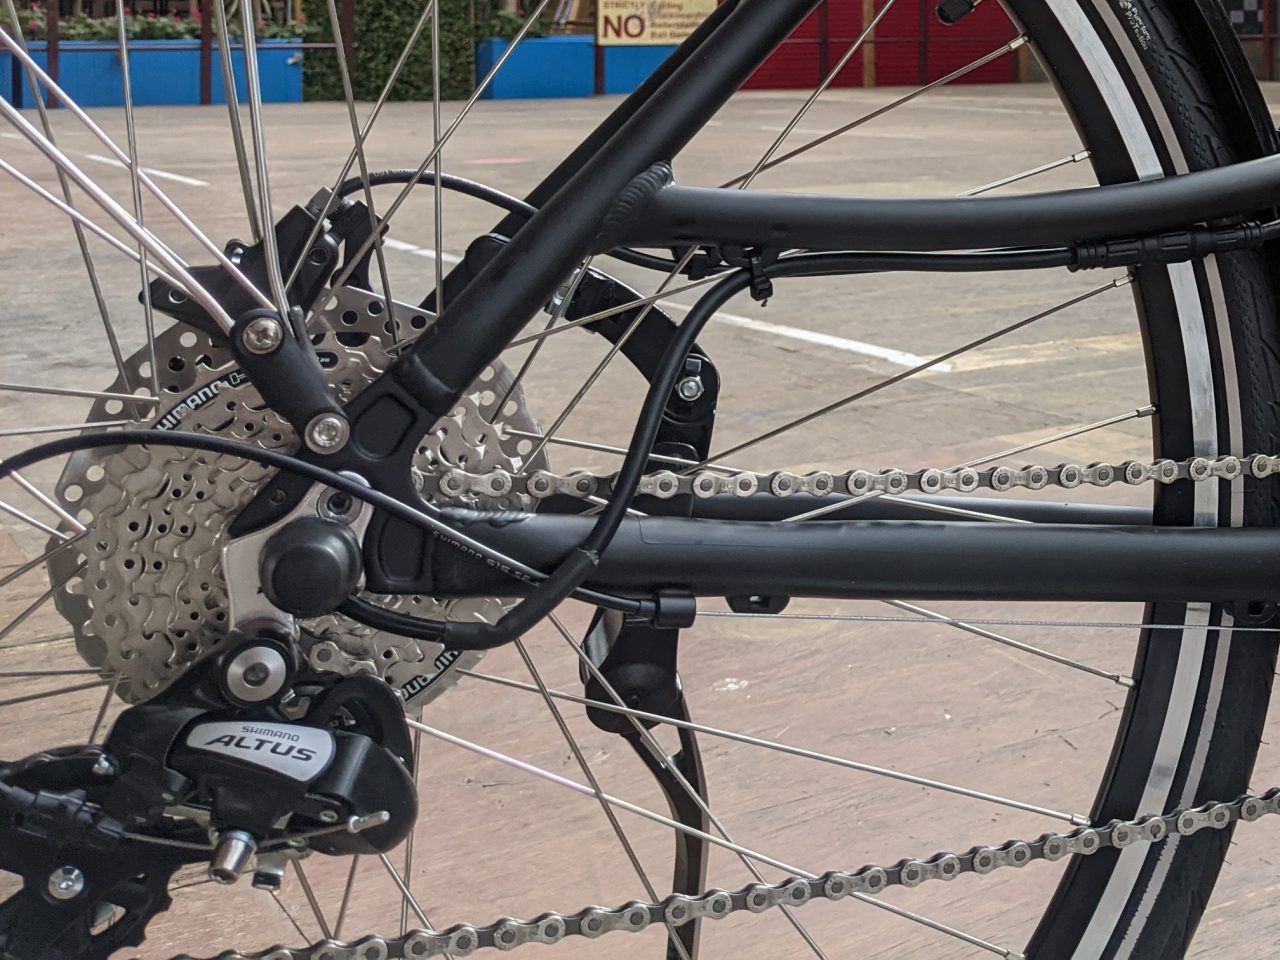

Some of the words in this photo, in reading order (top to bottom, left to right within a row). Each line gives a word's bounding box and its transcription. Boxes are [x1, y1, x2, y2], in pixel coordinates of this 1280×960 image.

[603, 0, 645, 9] STRICTLY
[603, 14, 645, 38] NO
[155, 381, 228, 432] HIMANO
[241, 725, 301, 742] SHIMANO
[203, 734, 318, 762] ALTUS
